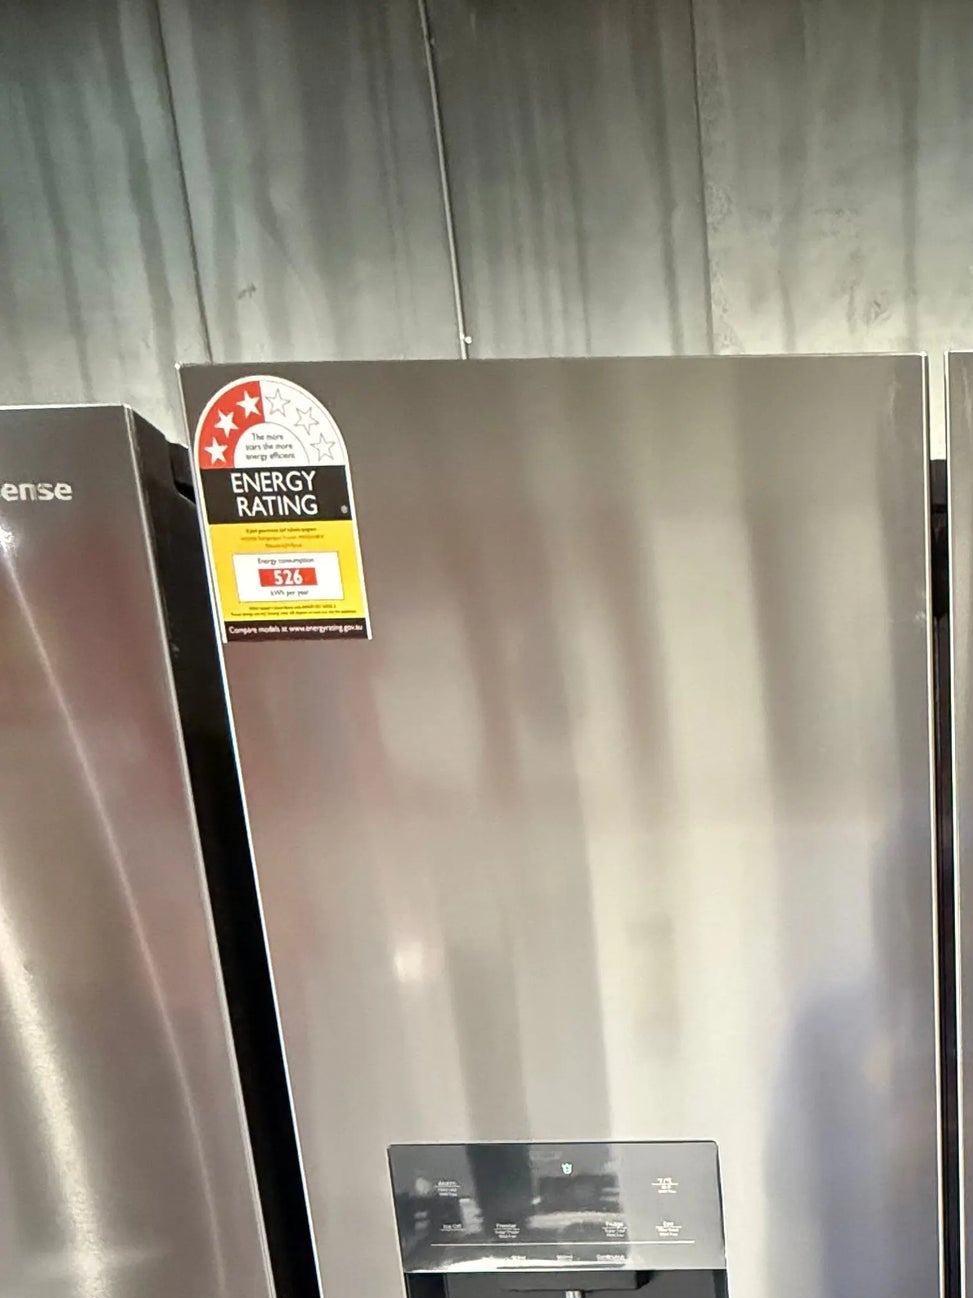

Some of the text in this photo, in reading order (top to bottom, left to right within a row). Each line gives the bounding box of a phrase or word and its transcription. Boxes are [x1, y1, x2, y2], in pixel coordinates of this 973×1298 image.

[0, 482, 73, 502] ense
[230, 470, 316, 493] ENERGY
[236, 494, 319, 517] RATING
[273, 569, 304, 585] 526
